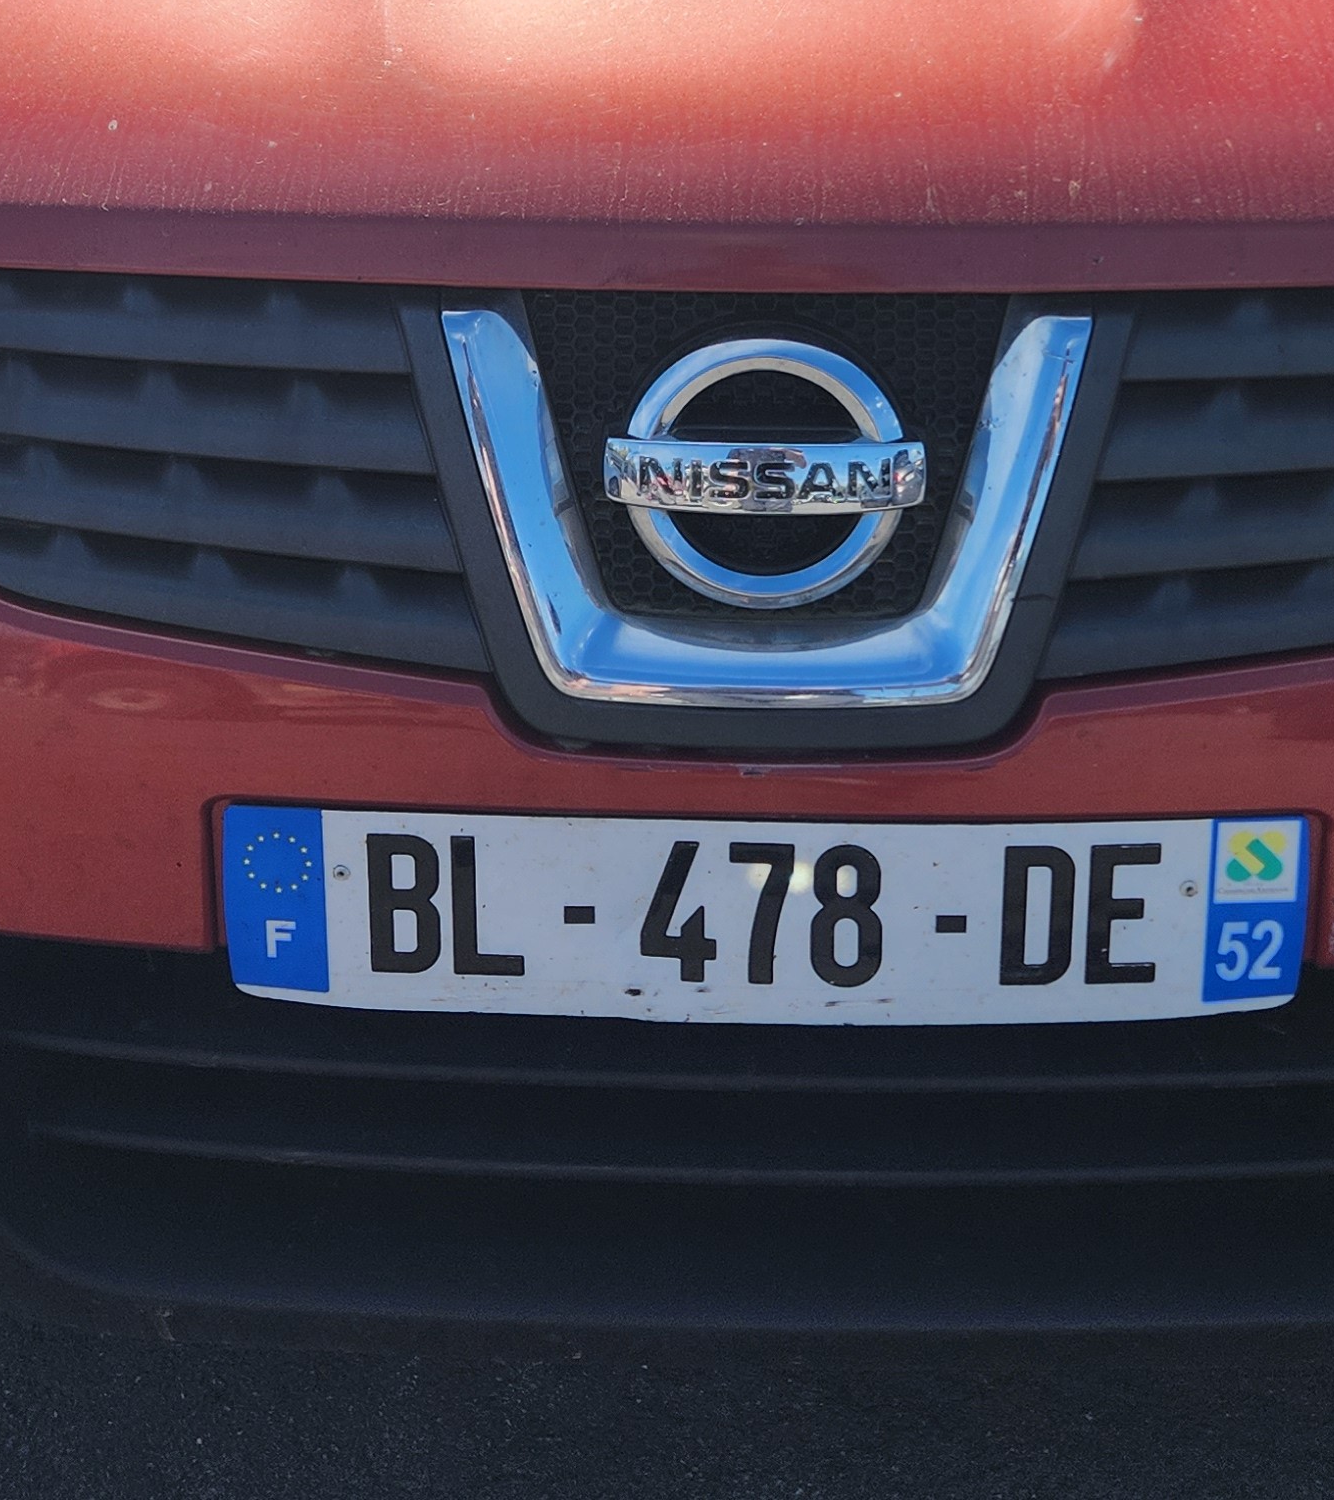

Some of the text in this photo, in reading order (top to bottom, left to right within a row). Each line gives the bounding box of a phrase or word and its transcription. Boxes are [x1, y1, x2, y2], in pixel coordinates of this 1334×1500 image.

[637, 454, 895, 502] NISSAN
[264, 919, 296, 959] F
[1214, 919, 1285, 982] 52
